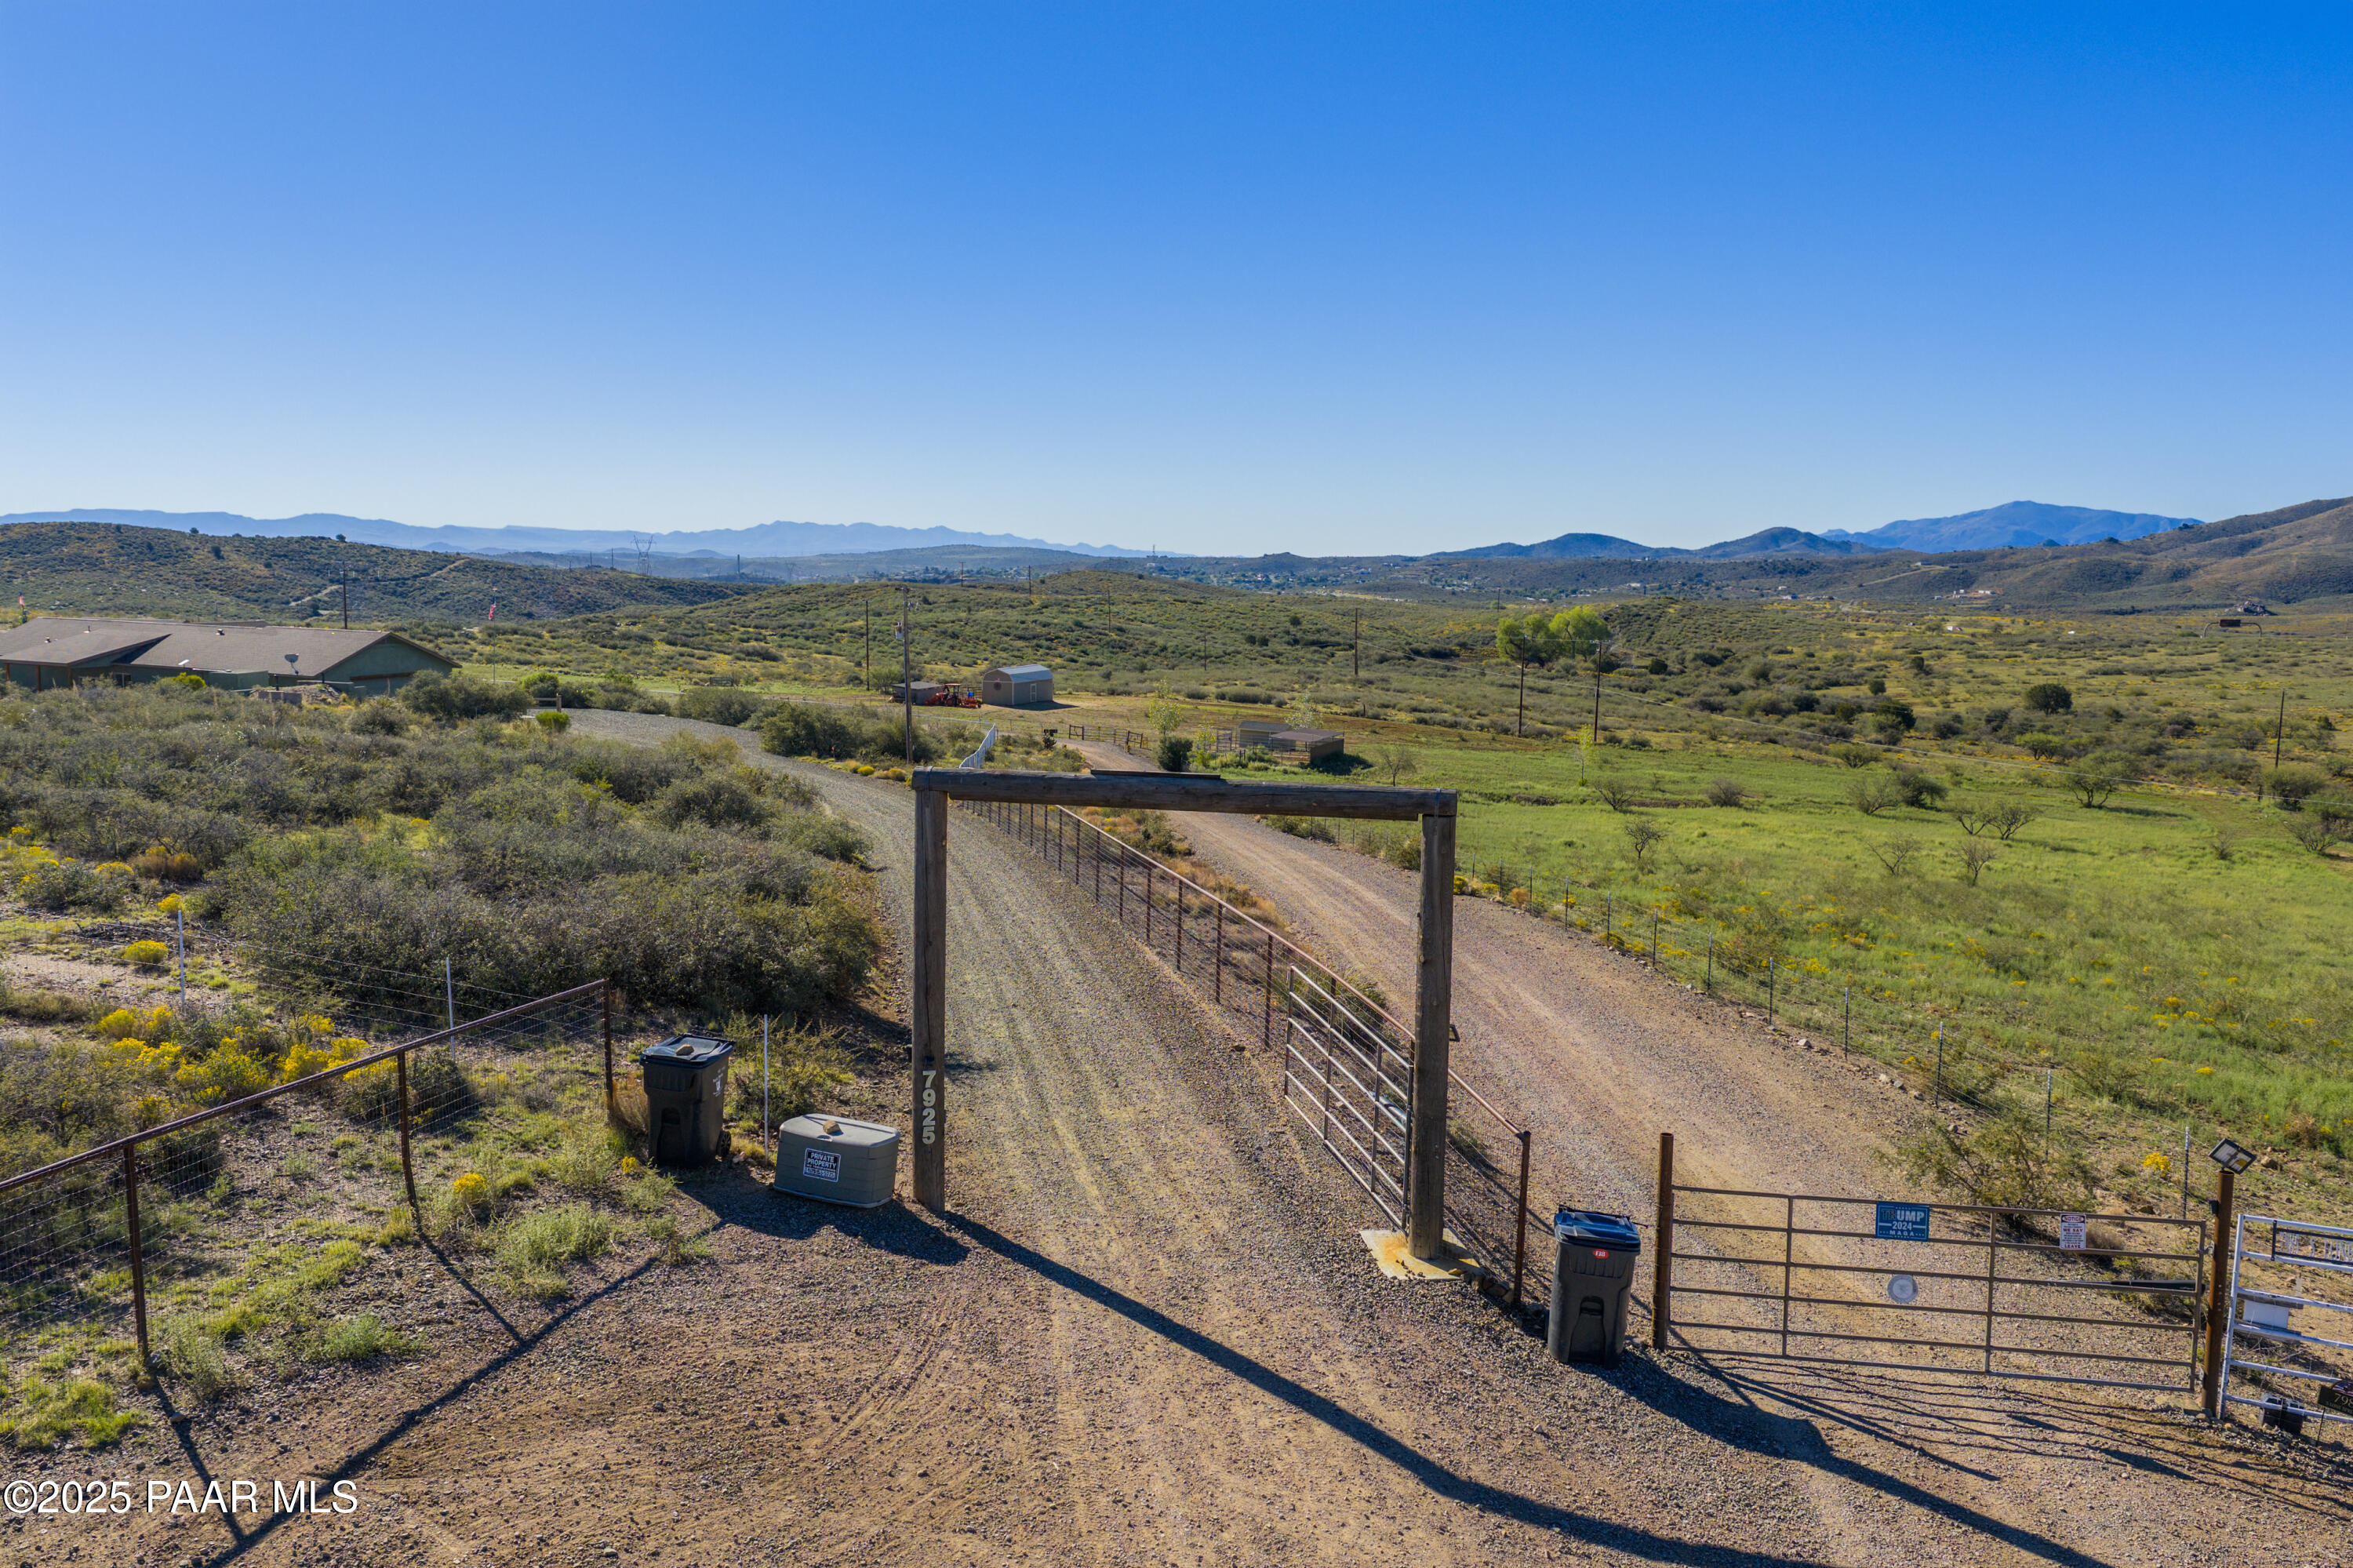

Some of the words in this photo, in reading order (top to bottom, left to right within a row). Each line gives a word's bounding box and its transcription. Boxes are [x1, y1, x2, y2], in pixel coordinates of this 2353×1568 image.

[922, 1070, 936, 1144] 7925
[810, 1152, 835, 1162] PRIVATE
[807, 1158, 836, 1169] PROPERTY
[1882, 1208, 1925, 1222] TRUMP
[1892, 1221, 1912, 1230] 2024
